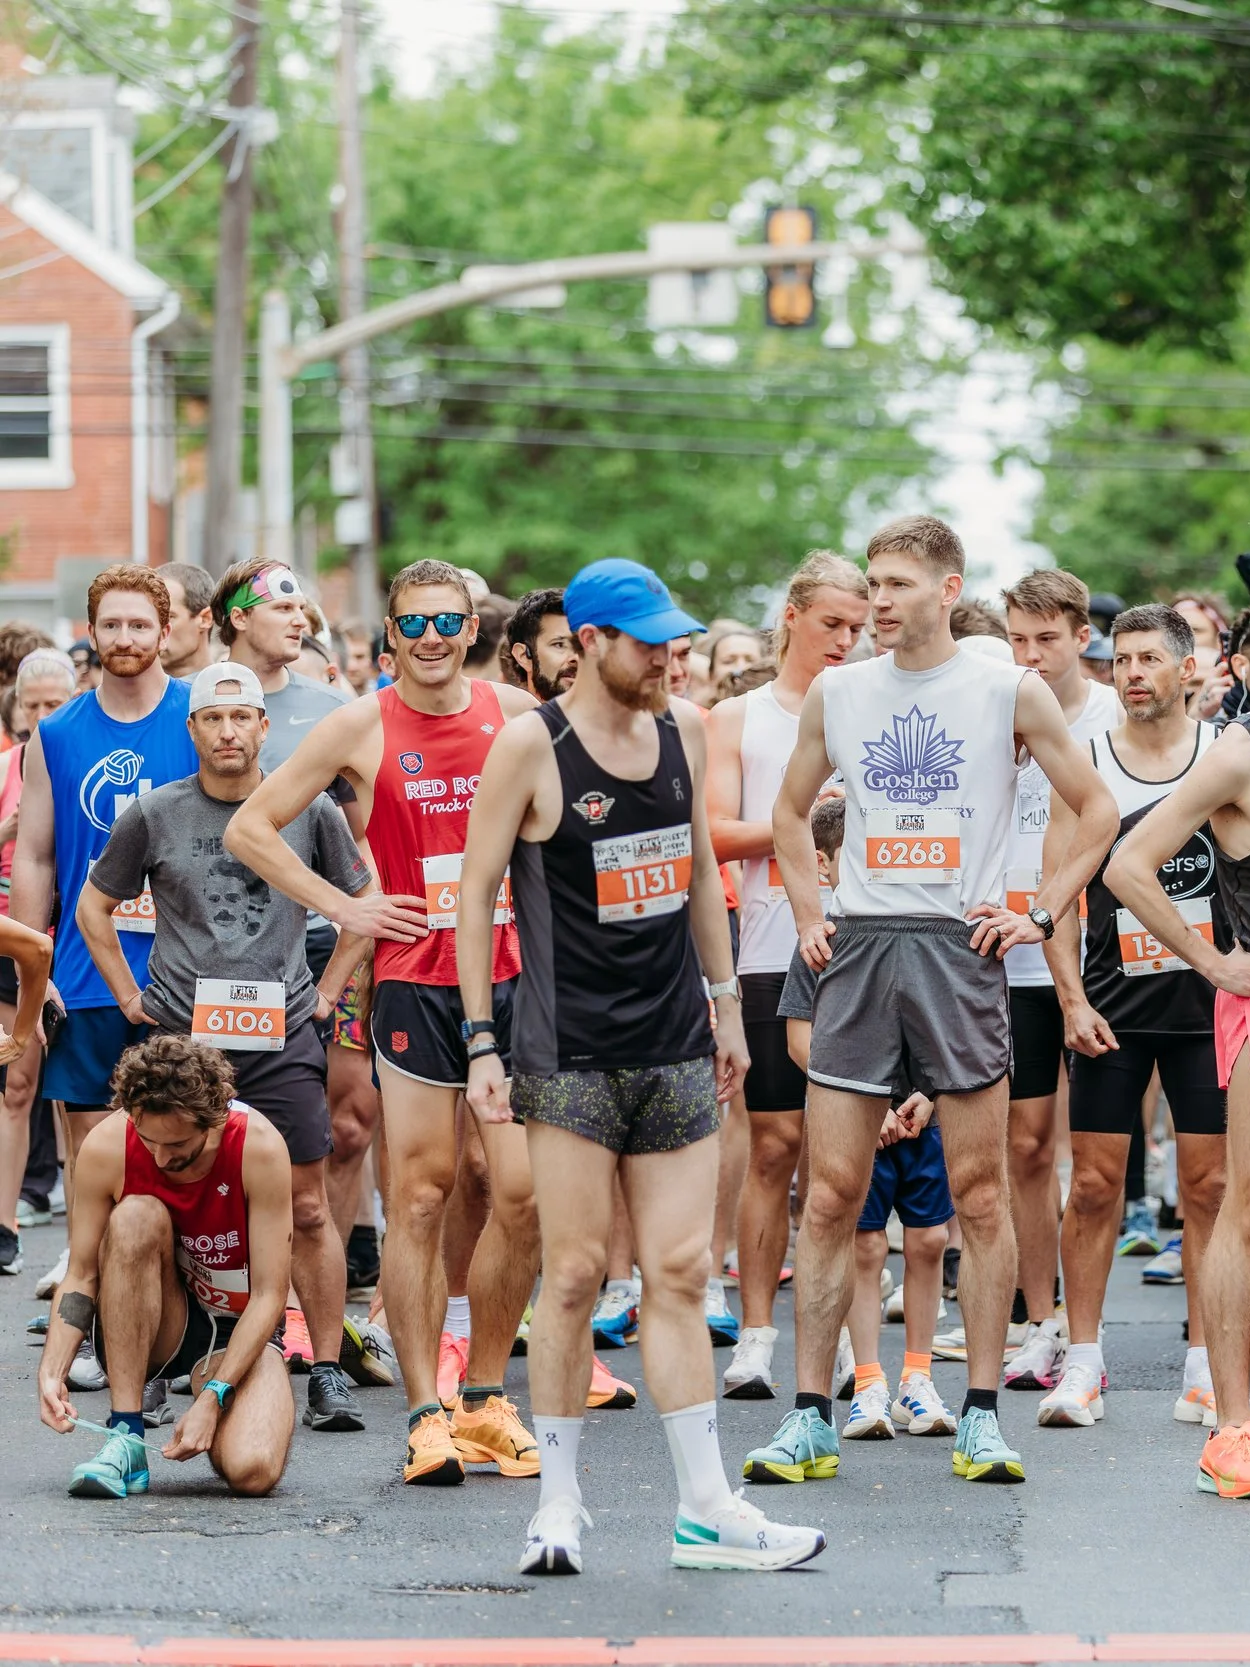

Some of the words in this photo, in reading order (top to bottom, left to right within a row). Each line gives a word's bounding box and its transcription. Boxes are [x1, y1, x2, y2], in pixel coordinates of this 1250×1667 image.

[404, 779, 447, 800] RED
[452, 774, 482, 795] RO
[867, 768, 955, 789] Goshen
[890, 789, 935, 802] College
[420, 798, 465, 815] Track
[1021, 808, 1049, 826] MUN
[876, 841, 947, 865] 6268
[1162, 857, 1196, 872] ers
[622, 863, 676, 899] 1131
[207, 1009, 273, 1034] 6106
[181, 1230, 240, 1252] ROSE
